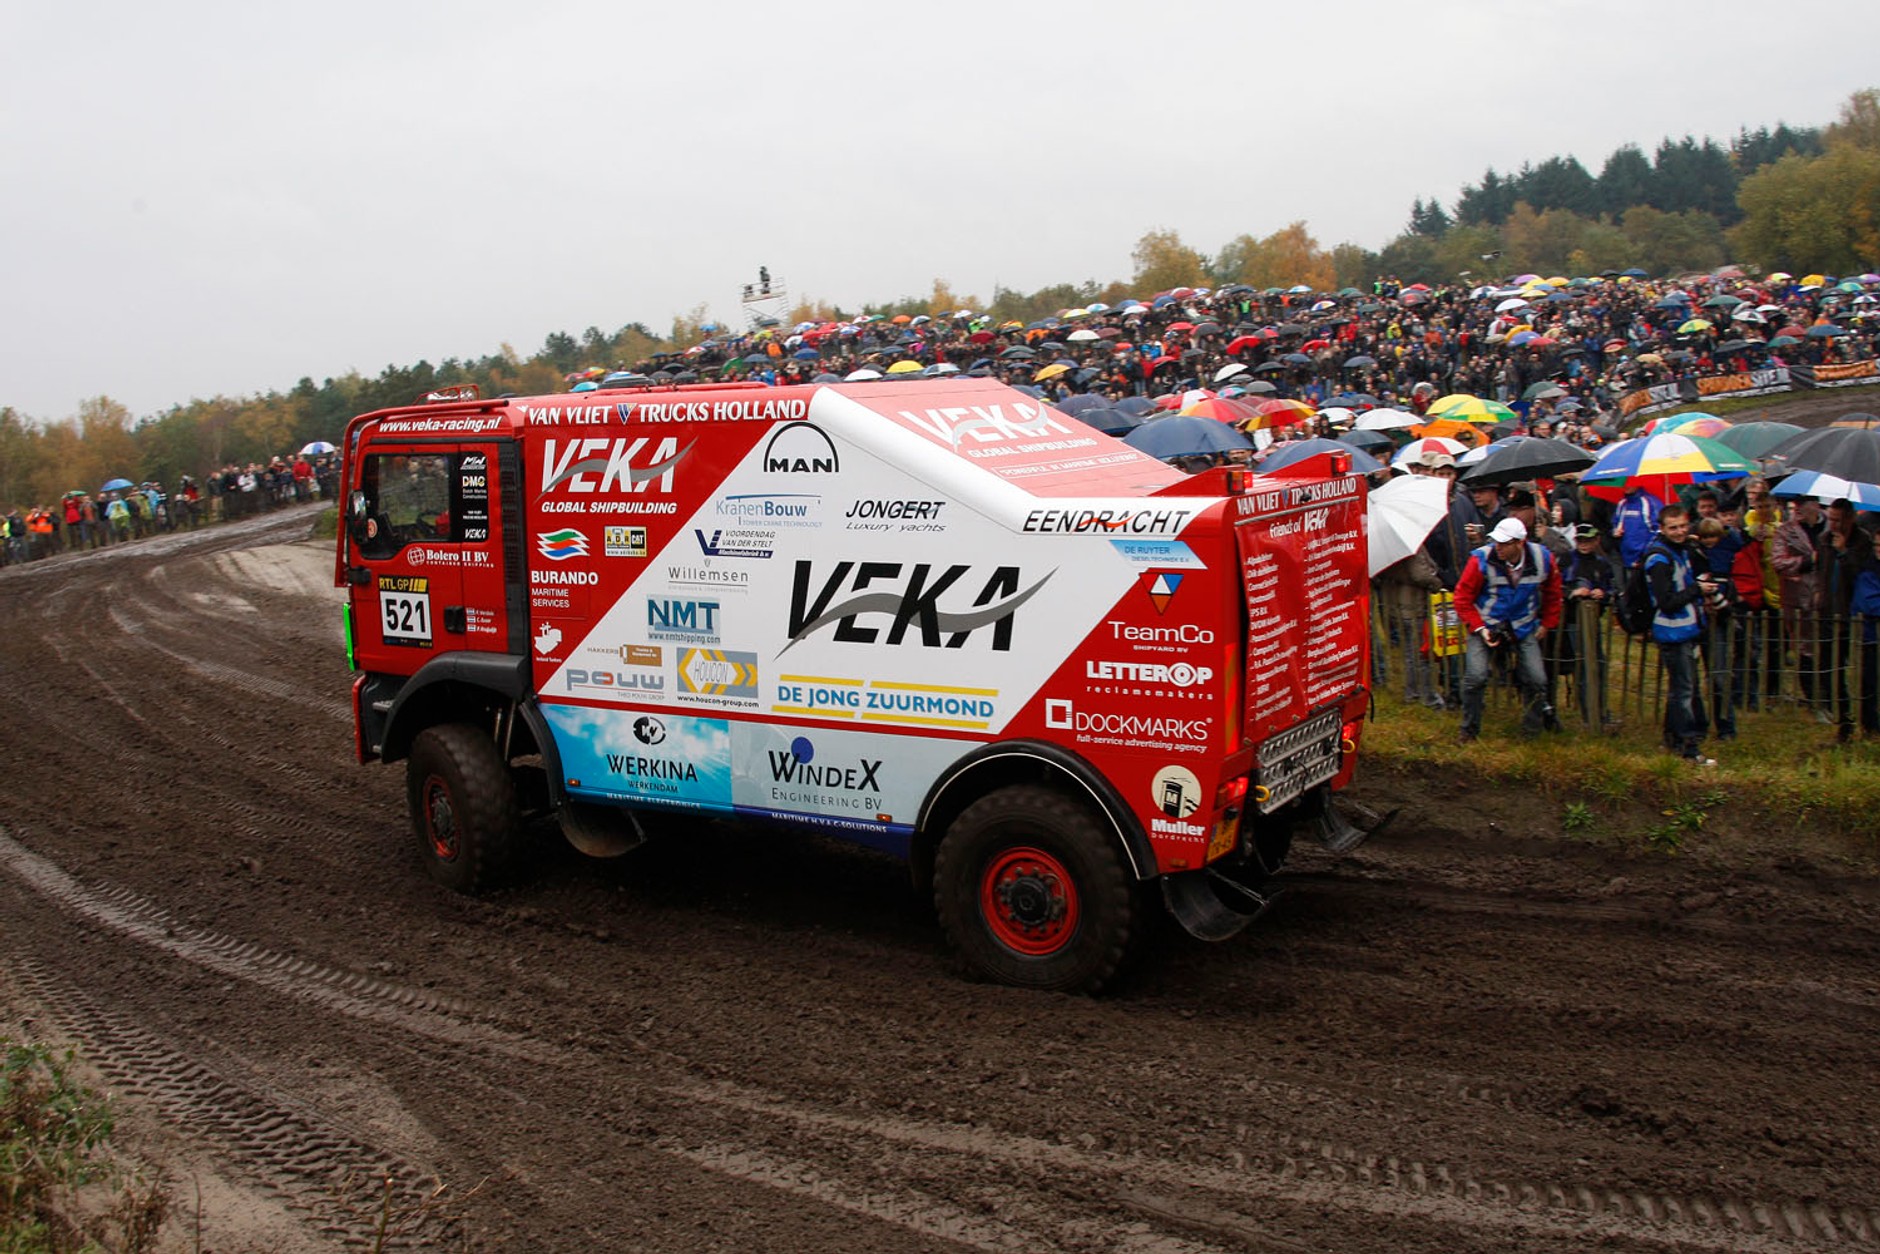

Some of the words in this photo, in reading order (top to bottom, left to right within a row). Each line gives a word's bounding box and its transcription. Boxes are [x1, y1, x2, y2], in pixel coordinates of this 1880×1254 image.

[528, 407, 560, 425] VAN
[566, 405, 612, 424] VLIET
[639, 401, 709, 423] TRUCKS
[713, 399, 806, 421] HOLLAND
[379, 416, 503, 433] www.veka-racing.nl
[897, 402, 1074, 445] VEKA
[968, 446, 1016, 458] GLOBAL
[1017, 437, 1098, 454] SHIPBUILDING
[541, 437, 678, 493] VEKA
[769, 458, 833, 473] MAN
[1237, 496, 1255, 515] VAN
[1257, 491, 1280, 512] VLIET
[1291, 484, 1321, 505] TRCKS
[1322, 477, 1356, 498] HOLLAND
[541, 501, 588, 513] GLOBAL
[590, 501, 677, 515] SHIPBUILDING
[716, 500, 808, 517] KranenBouw
[846, 500, 946, 520] JONGERT
[846, 521, 894, 532] Luxury
[899, 523, 947, 532] yachts
[1022, 510, 1191, 533] EENDRACHT
[631, 534, 644, 545] CAT
[725, 530, 776, 539] VOORDENDAG
[426, 549, 459, 562] Bolero
[462, 551, 472, 562] II
[474, 551, 489, 563] BV
[1124, 546, 1136, 554] DE
[1137, 546, 1171, 554] RUYTER
[531, 570, 599, 585] BURANDO
[668, 566, 749, 582] Willemsen
[379, 577, 396, 590] RTL
[531, 588, 569, 597] MARITIME
[532, 598, 570, 608] SERVICES
[788, 559, 1020, 652] VEKA
[385, 598, 426, 633] 521
[648, 599, 720, 630] NMT
[648, 632, 721, 644] www.nmtshipping.com
[1107, 620, 1214, 644] TeamCo
[695, 661, 729, 683] HOUCON
[1086, 660, 1214, 688] LETTEROP
[677, 694, 759, 708] www.houcon-group.com
[1086, 685, 1214, 700] reclamemakers
[778, 685, 802, 703] DE
[807, 688, 860, 708] JONG
[867, 692, 994, 718] ZUURMOND
[1076, 733, 1124, 745] full-service
[1124, 737, 1173, 751] advertising
[1174, 743, 1207, 754] agency
[606, 754, 699, 783] WERKINA
[628, 780, 678, 793] WERKENDAM
[771, 787, 860, 809] ENGINEERING
[865, 797, 883, 811] BV
[771, 812, 809, 824] MARITIME
[1151, 818, 1206, 837] Muller
[1151, 832, 1205, 844] Dordrecht
